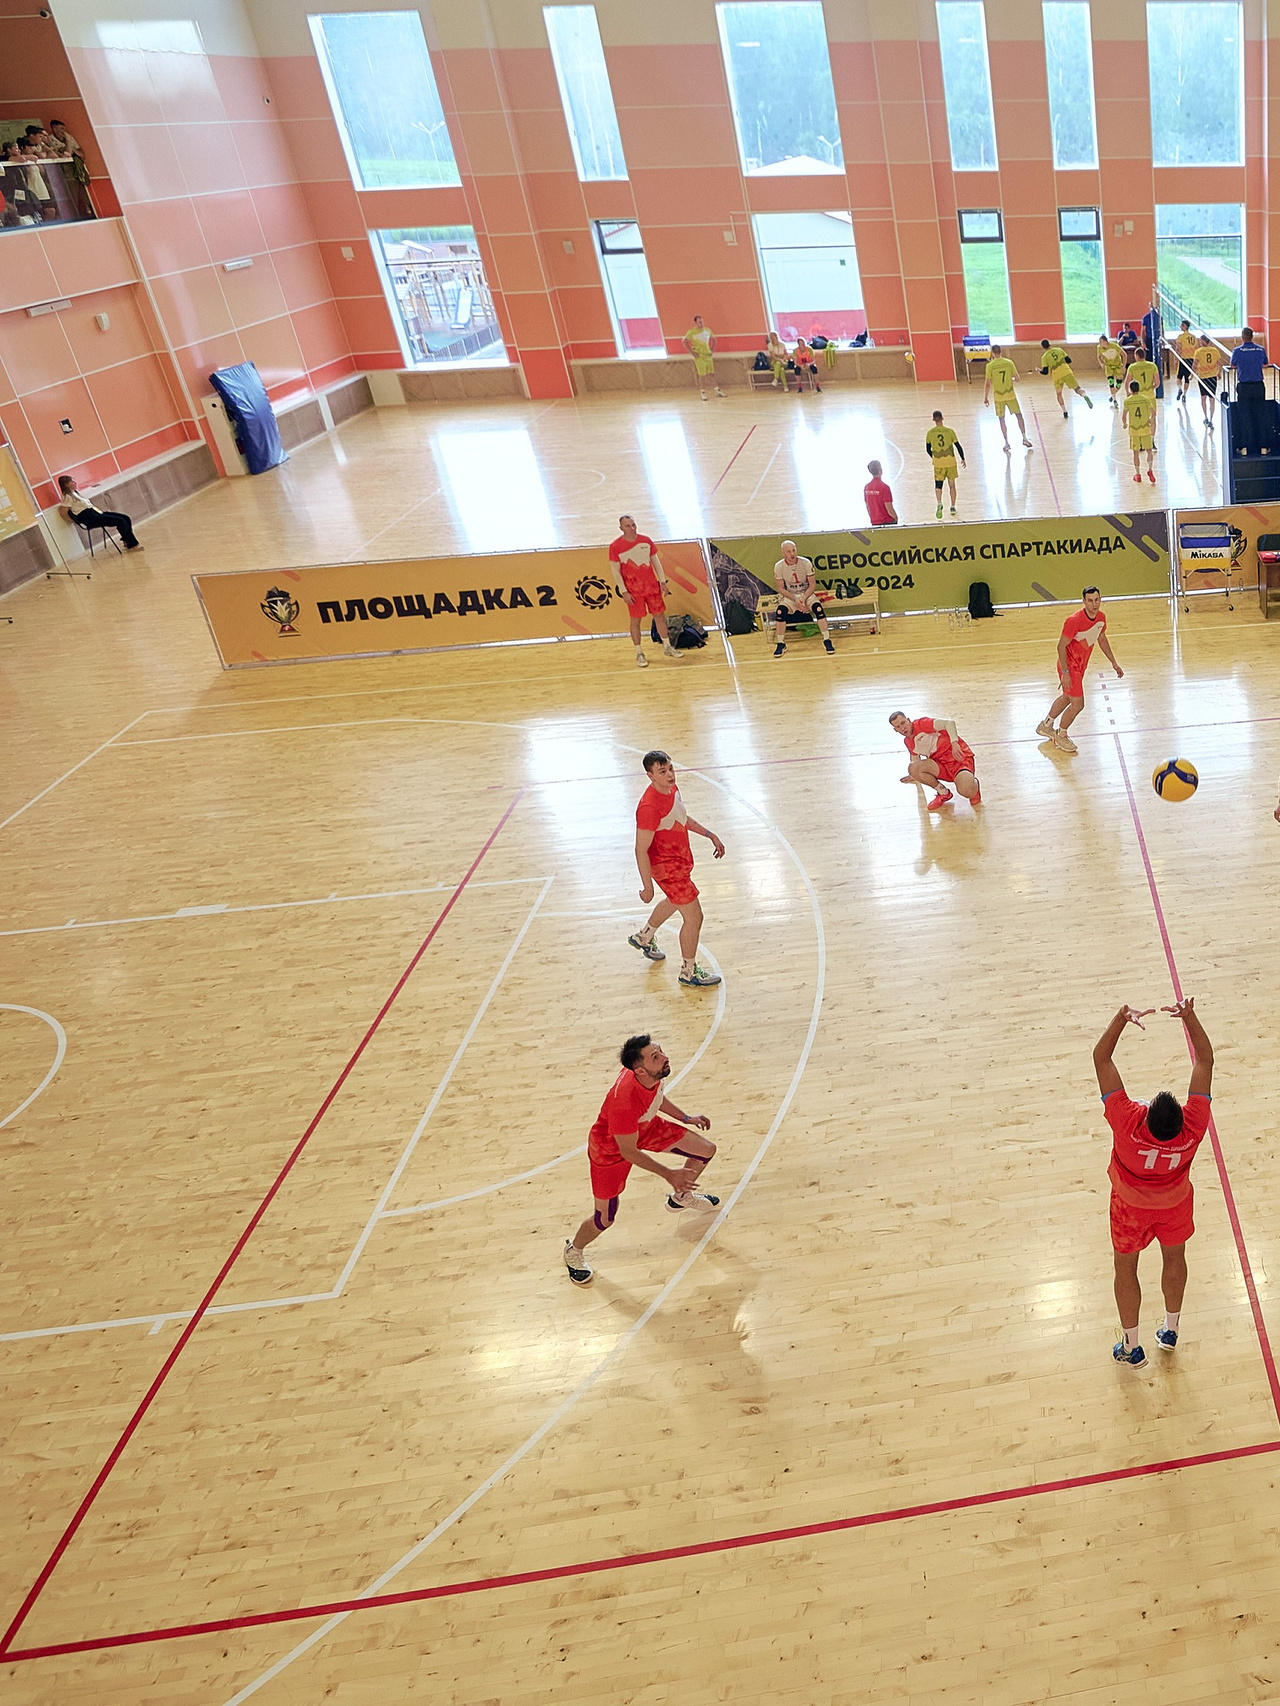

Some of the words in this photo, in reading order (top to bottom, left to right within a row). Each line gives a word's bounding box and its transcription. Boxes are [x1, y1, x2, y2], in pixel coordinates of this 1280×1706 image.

[1051, 352, 1058, 361] 5
[1206, 353, 1212, 363] 8
[999, 371, 1006, 383] 7
[1141, 372, 1147, 383] 1
[1134, 406, 1142, 419] 4
[937, 434, 945, 447] 3
[805, 544, 975, 571] СЕРОССИЙСКАЯ
[979, 535, 1126, 560] СПАРТАКИАДА
[792, 573, 800, 584] 1
[865, 574, 915, 591] 2024
[316, 586, 534, 624] ПЛОЩАДКА
[536, 585, 557, 606] 2
[1137, 1149, 1182, 1170] 11
